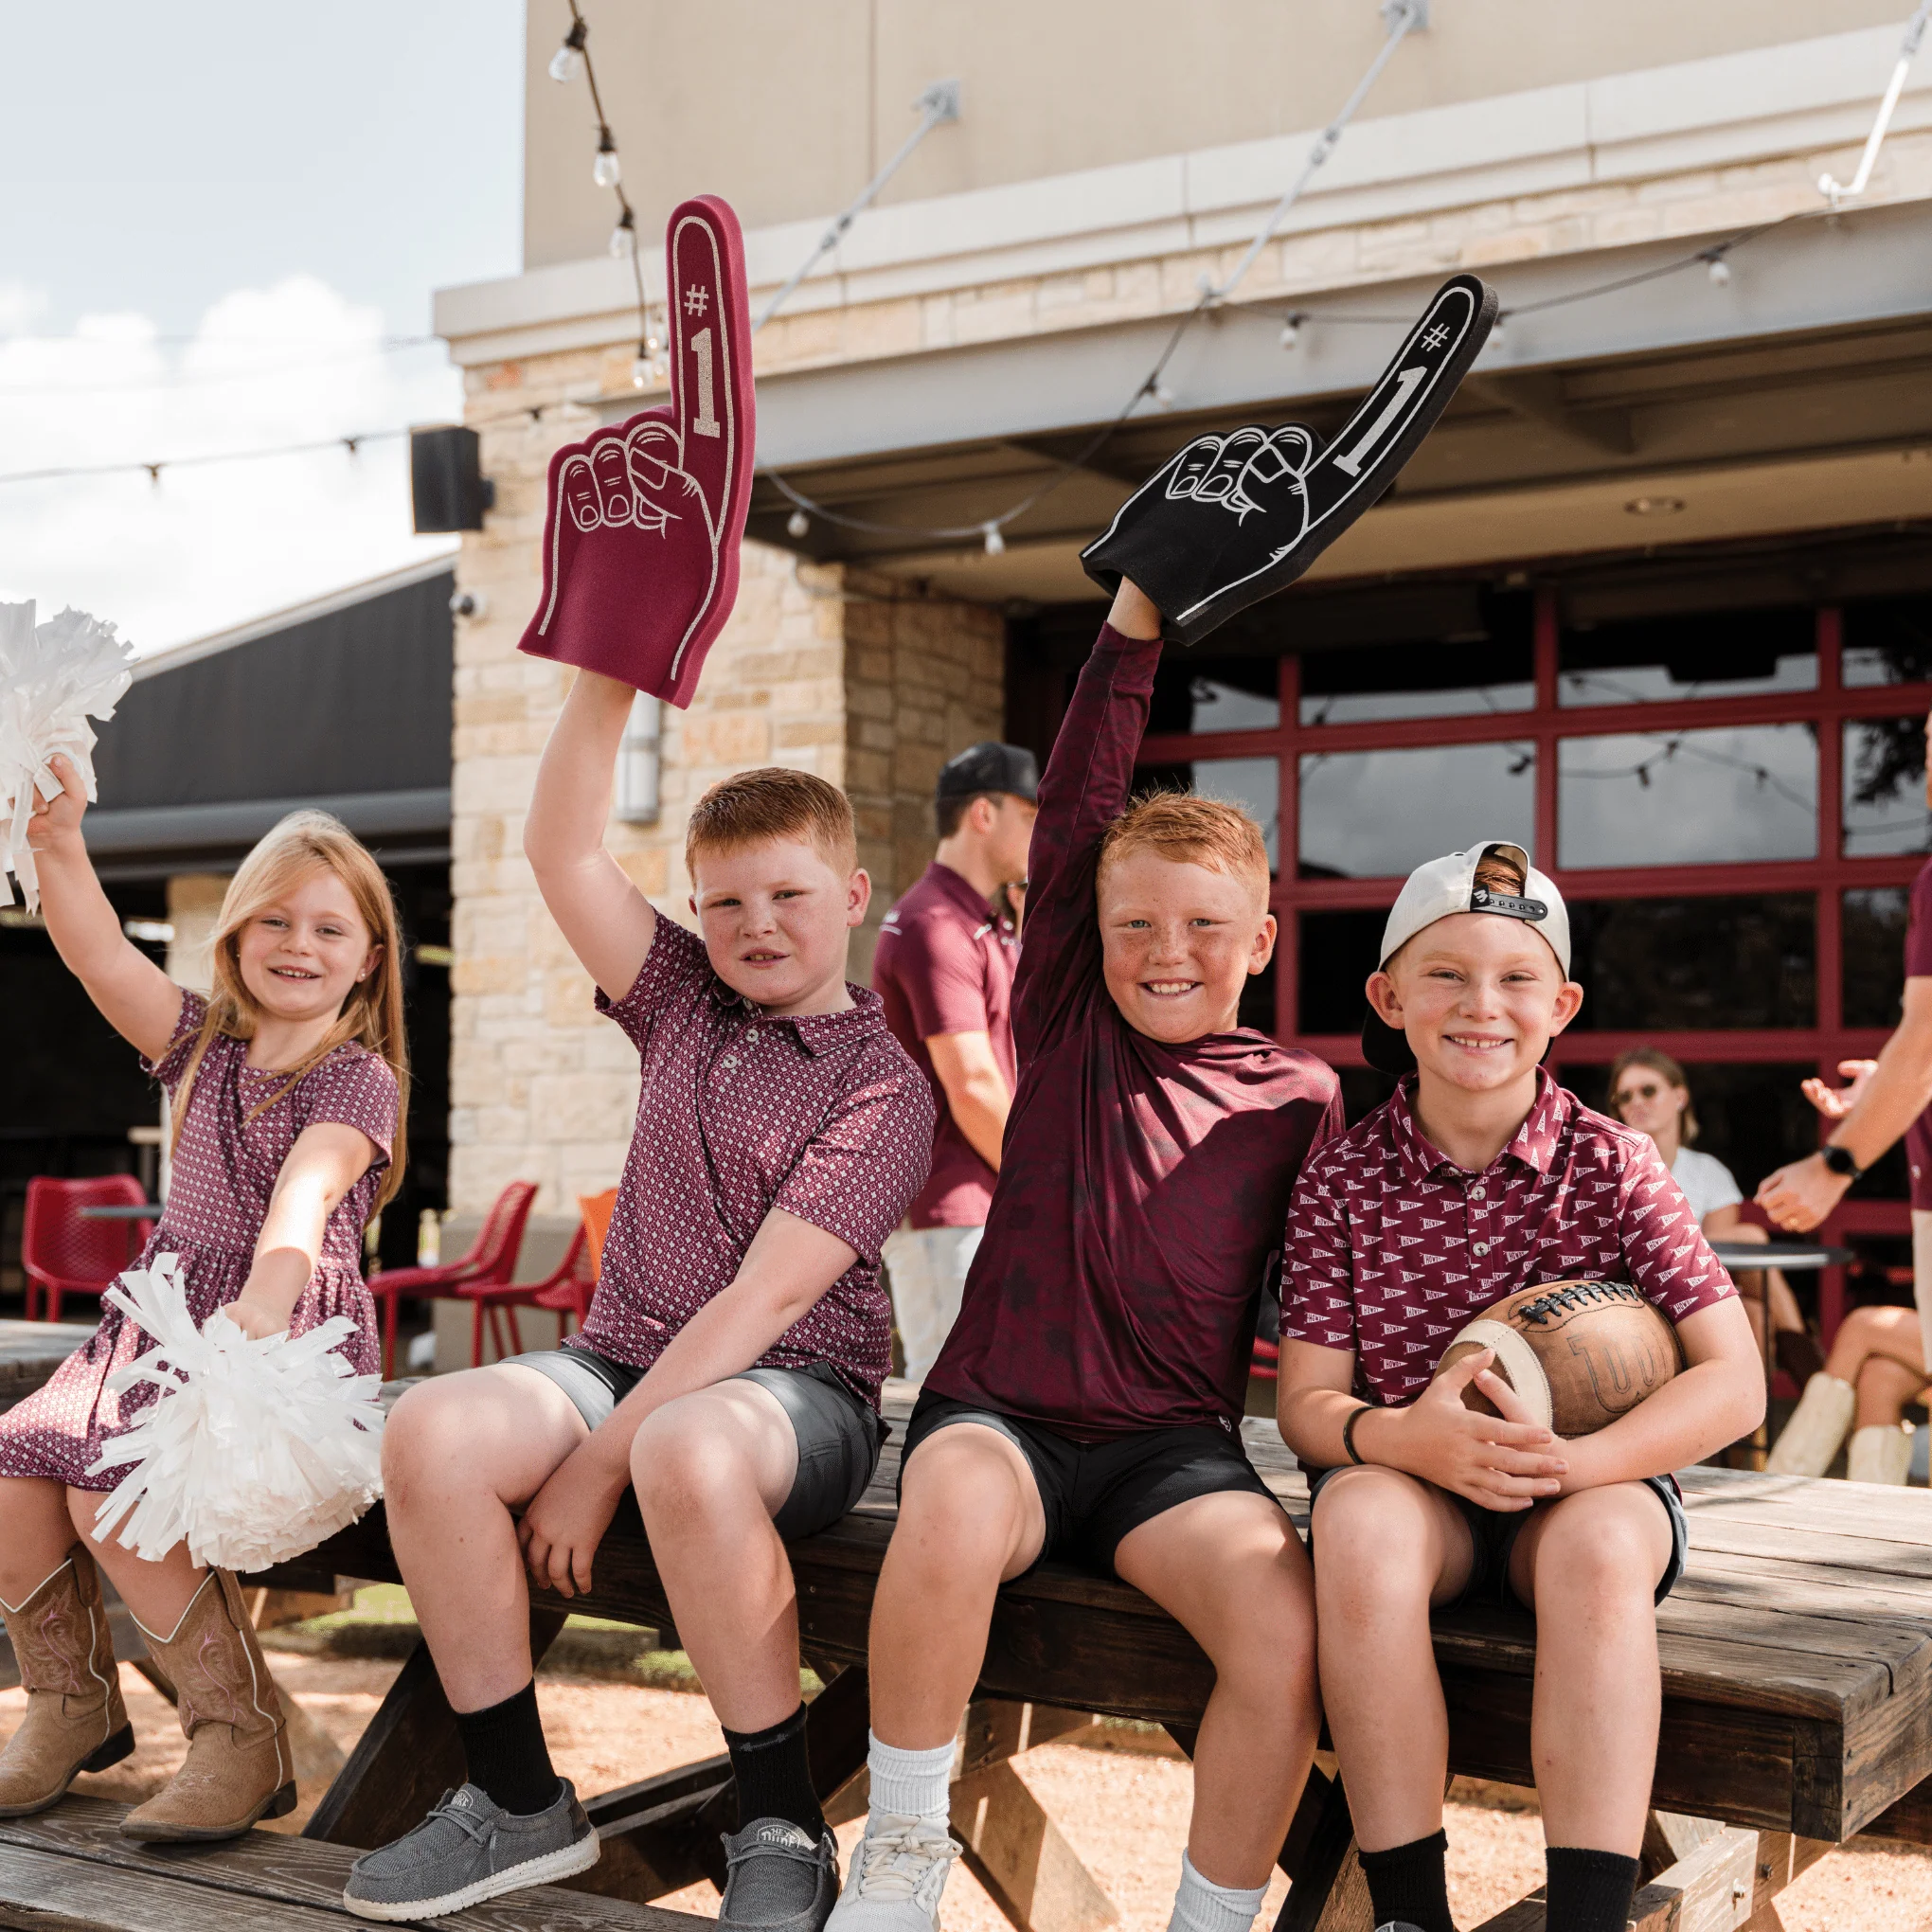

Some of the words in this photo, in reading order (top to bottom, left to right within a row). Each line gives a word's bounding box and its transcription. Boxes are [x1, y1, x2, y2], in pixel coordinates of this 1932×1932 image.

[684, 283, 709, 317] #
[1421, 322, 1450, 352] #
[690, 327, 721, 438] 1
[1333, 366, 1428, 477] 1
